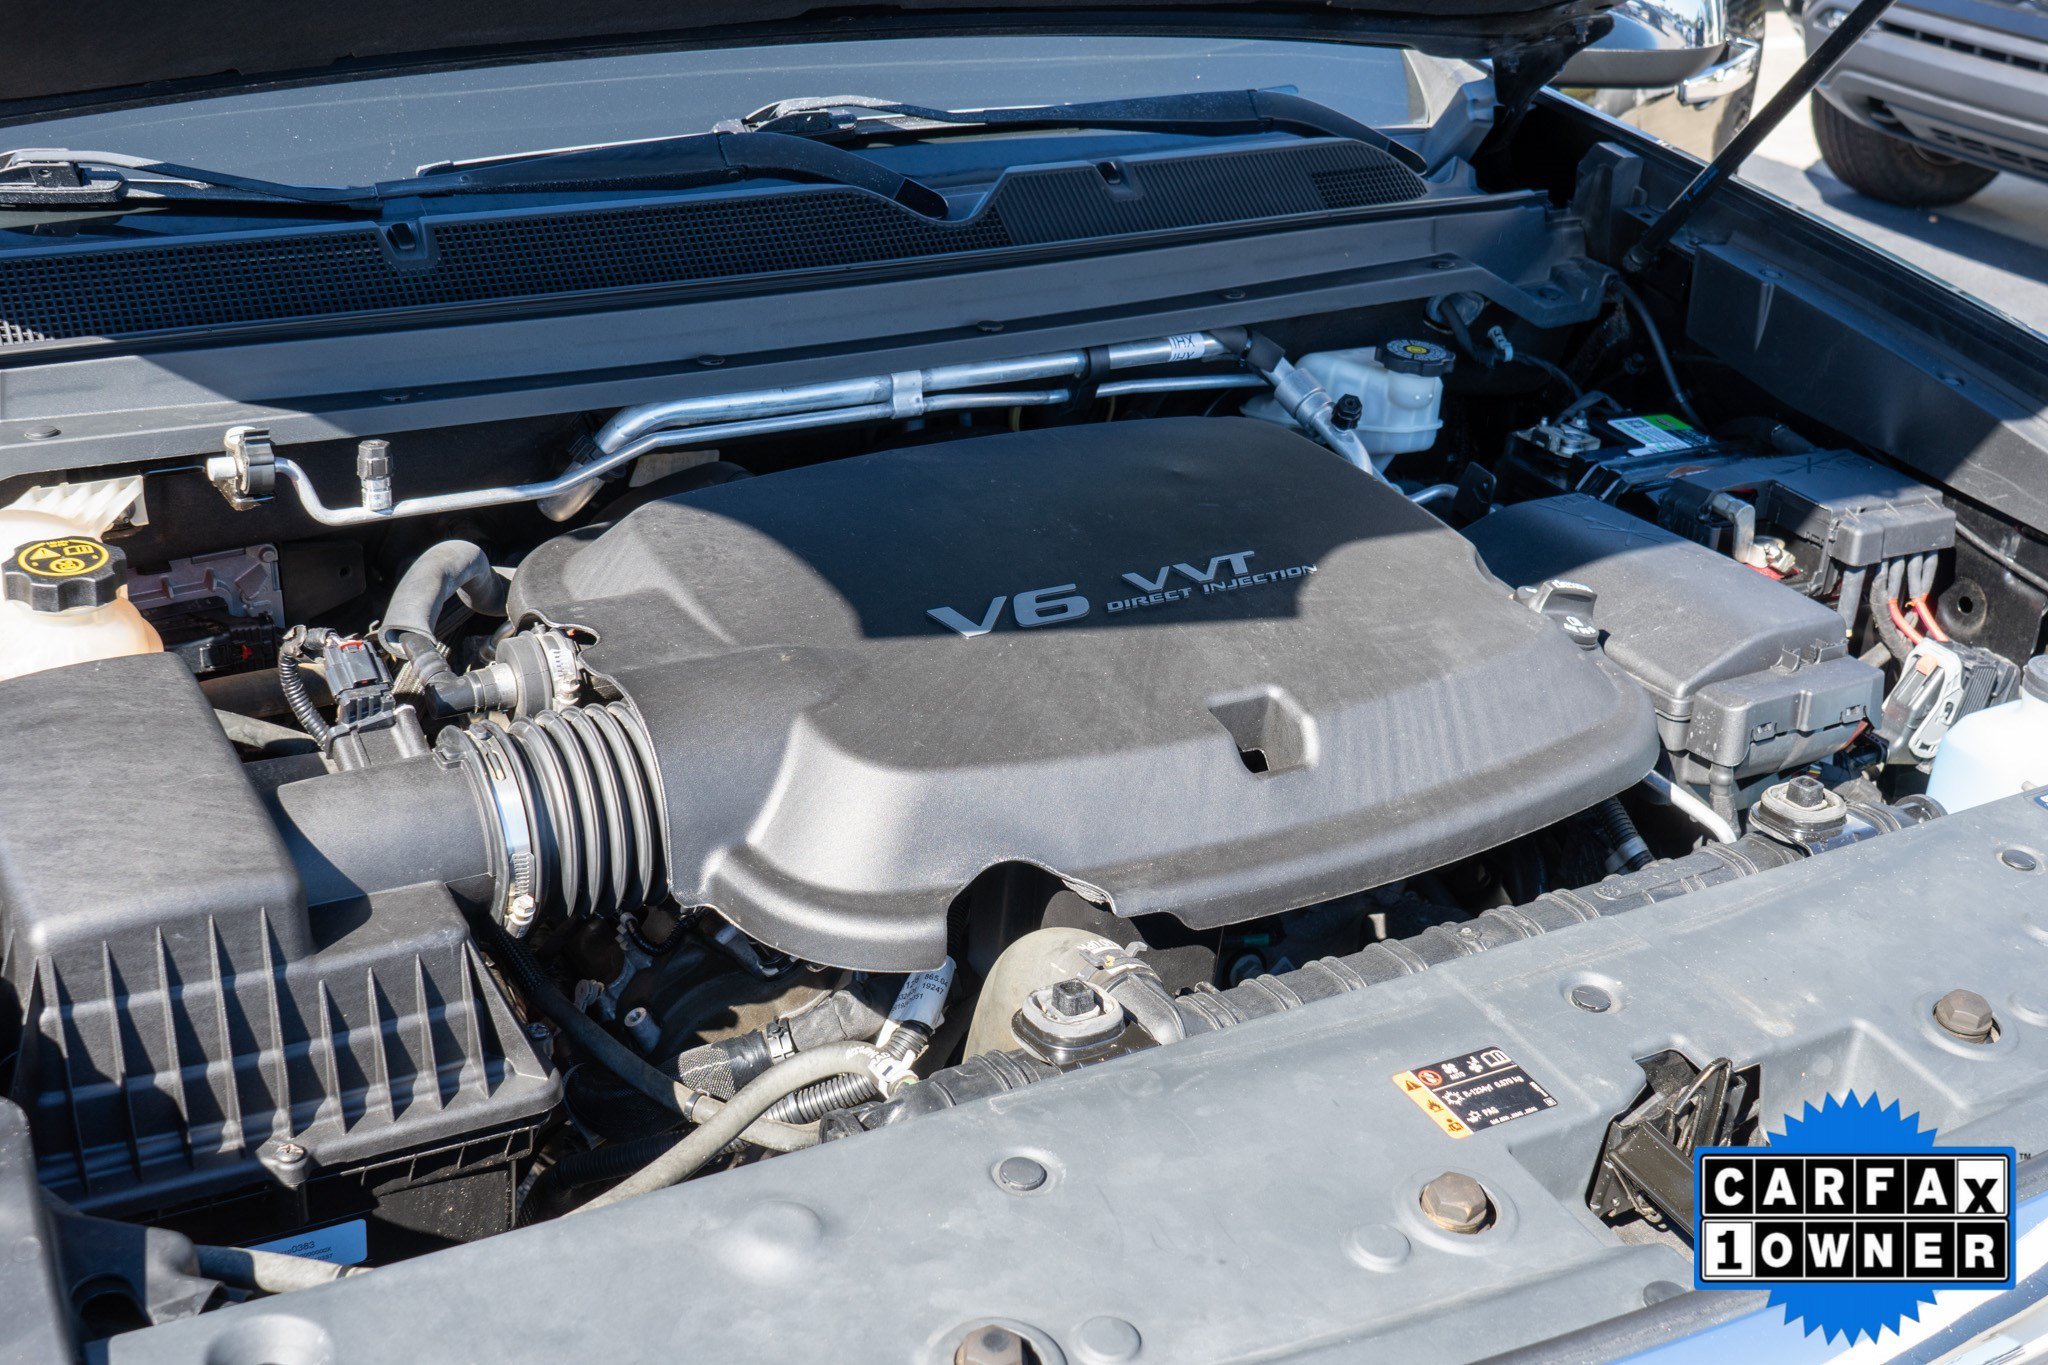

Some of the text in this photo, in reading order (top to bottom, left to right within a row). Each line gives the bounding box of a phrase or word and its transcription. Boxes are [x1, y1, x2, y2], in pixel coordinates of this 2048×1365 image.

[926, 550, 1255, 639] V6 VVT
[1106, 563, 1318, 613] DIRECT INJECTION
